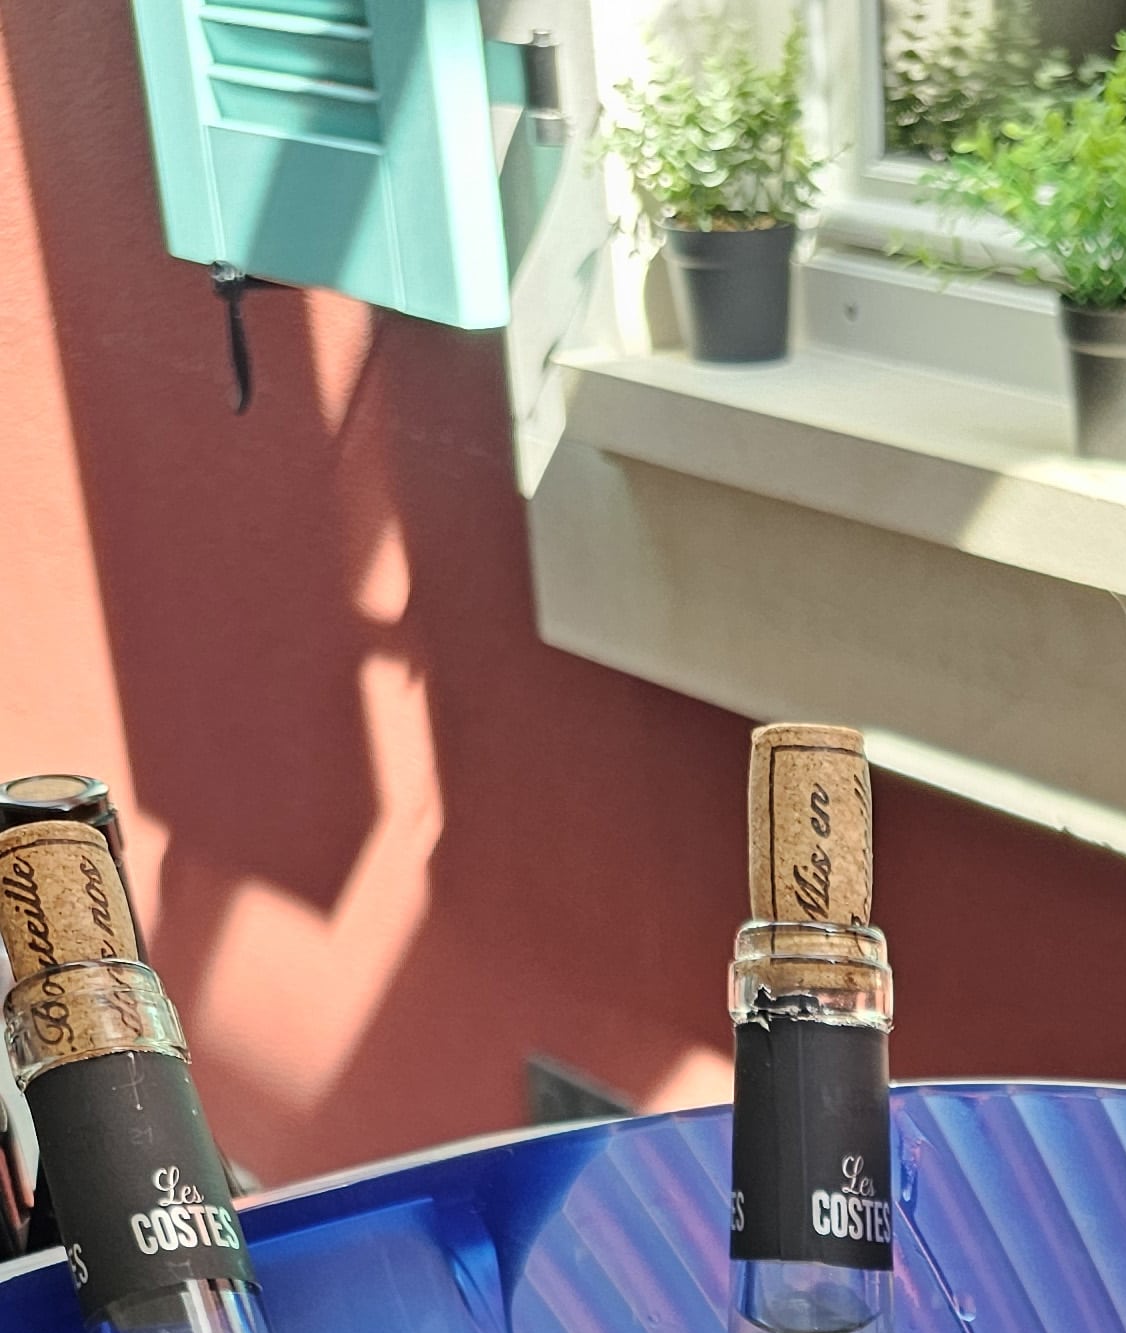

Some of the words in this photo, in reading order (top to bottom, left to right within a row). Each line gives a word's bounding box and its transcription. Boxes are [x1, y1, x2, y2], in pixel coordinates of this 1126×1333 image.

[811, 783, 830, 839] en
[82, 854, 112, 935] nos
[152, 1166, 204, 1207] Les
[841, 1153, 876, 1197] Les
[130, 1205, 240, 1257] COSTES
[811, 1189, 892, 1244] COSTES
